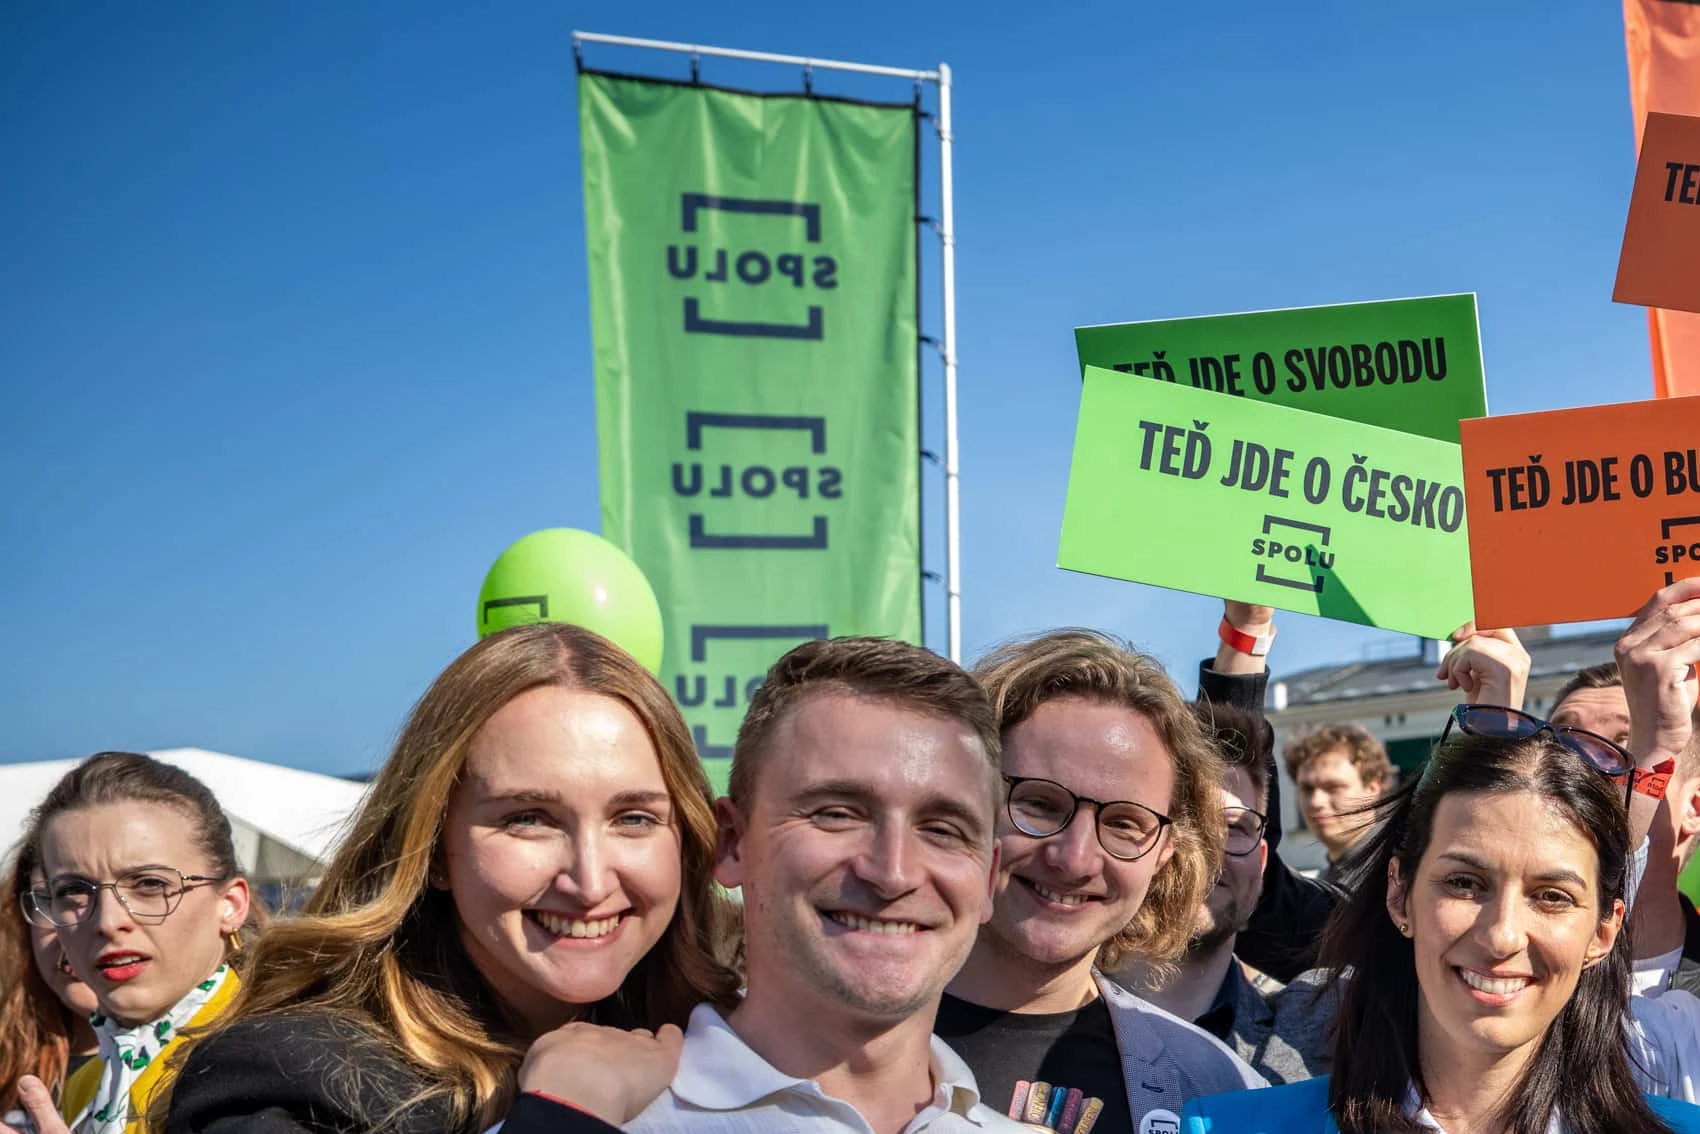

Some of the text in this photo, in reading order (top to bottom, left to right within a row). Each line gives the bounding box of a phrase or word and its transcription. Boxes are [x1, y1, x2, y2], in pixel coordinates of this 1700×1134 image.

[1188, 354, 1245, 397] JDE
[1253, 352, 1275, 395] O
[1284, 337, 1447, 392] SVOBODU
[1139, 420, 1464, 532] TEĎ JDE O ČESKO
[1486, 455, 1550, 512] TEĎ
[1562, 457, 1620, 505] JDE
[1630, 455, 1653, 497] O
[1251, 538, 1335, 569] SPOLU
